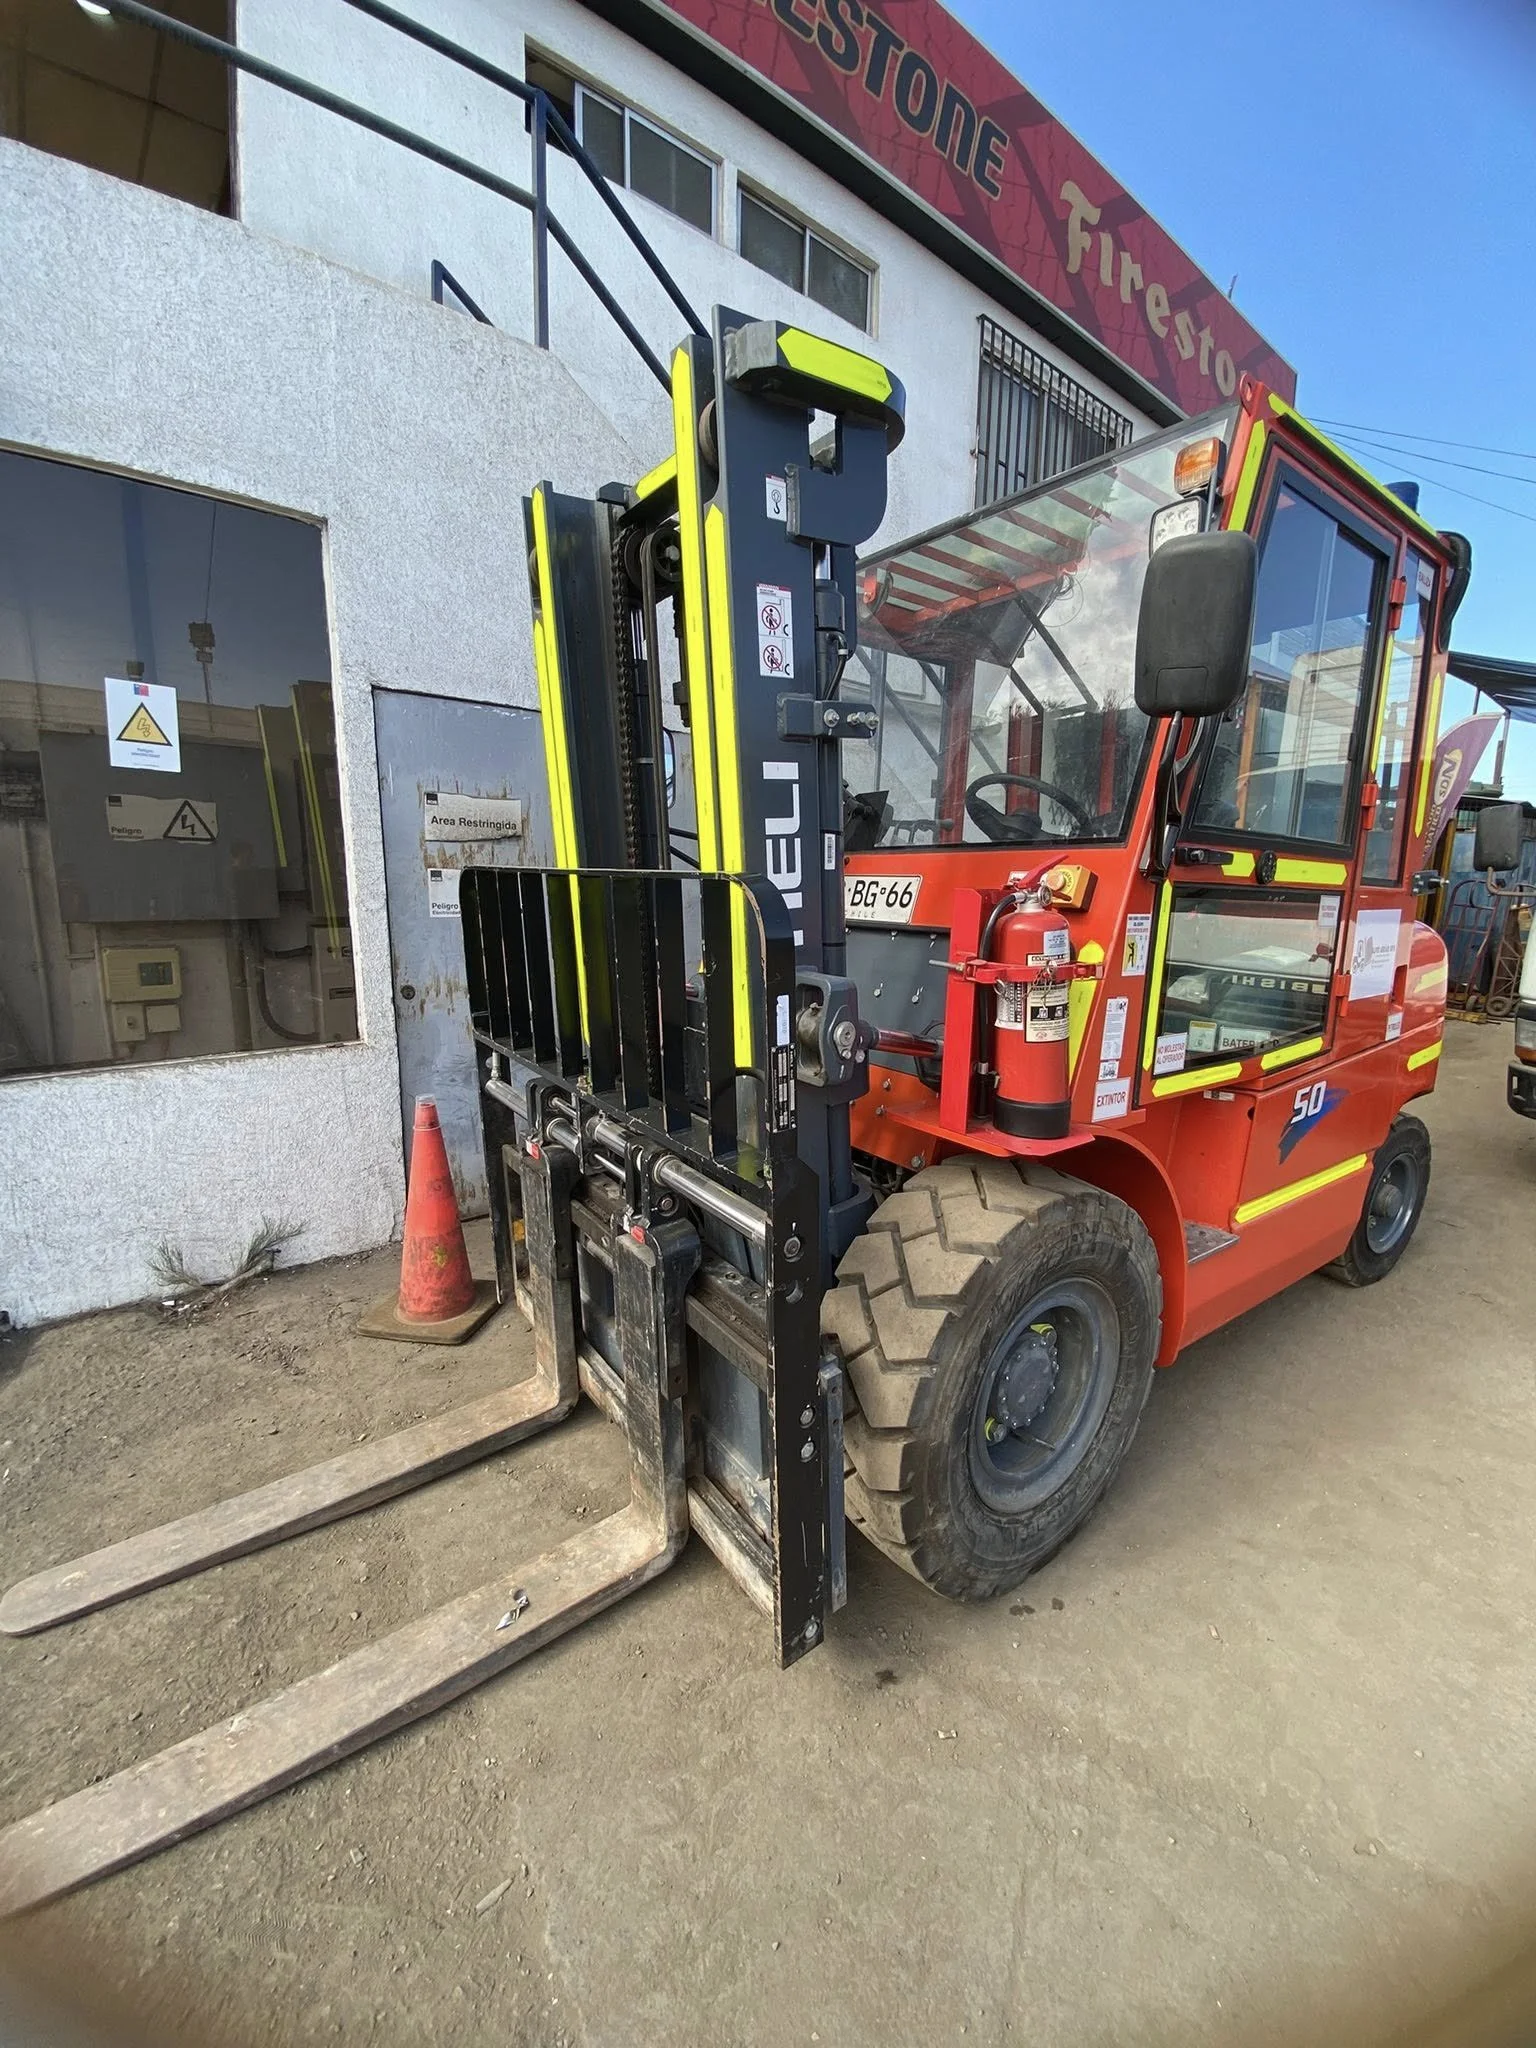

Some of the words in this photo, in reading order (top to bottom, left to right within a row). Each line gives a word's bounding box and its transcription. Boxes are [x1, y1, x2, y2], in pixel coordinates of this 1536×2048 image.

[756, 0, 1010, 201] ESTONE
[1059, 180, 1247, 397] Firesto
[111, 826, 143, 835] Peligro
[430, 815, 456, 826] Area
[459, 817, 517, 831] Restringida
[431, 902, 459, 911] Peligro
[1096, 1091, 1126, 1107] EXTINTOR
[1290, 1081, 1327, 1124] 50
